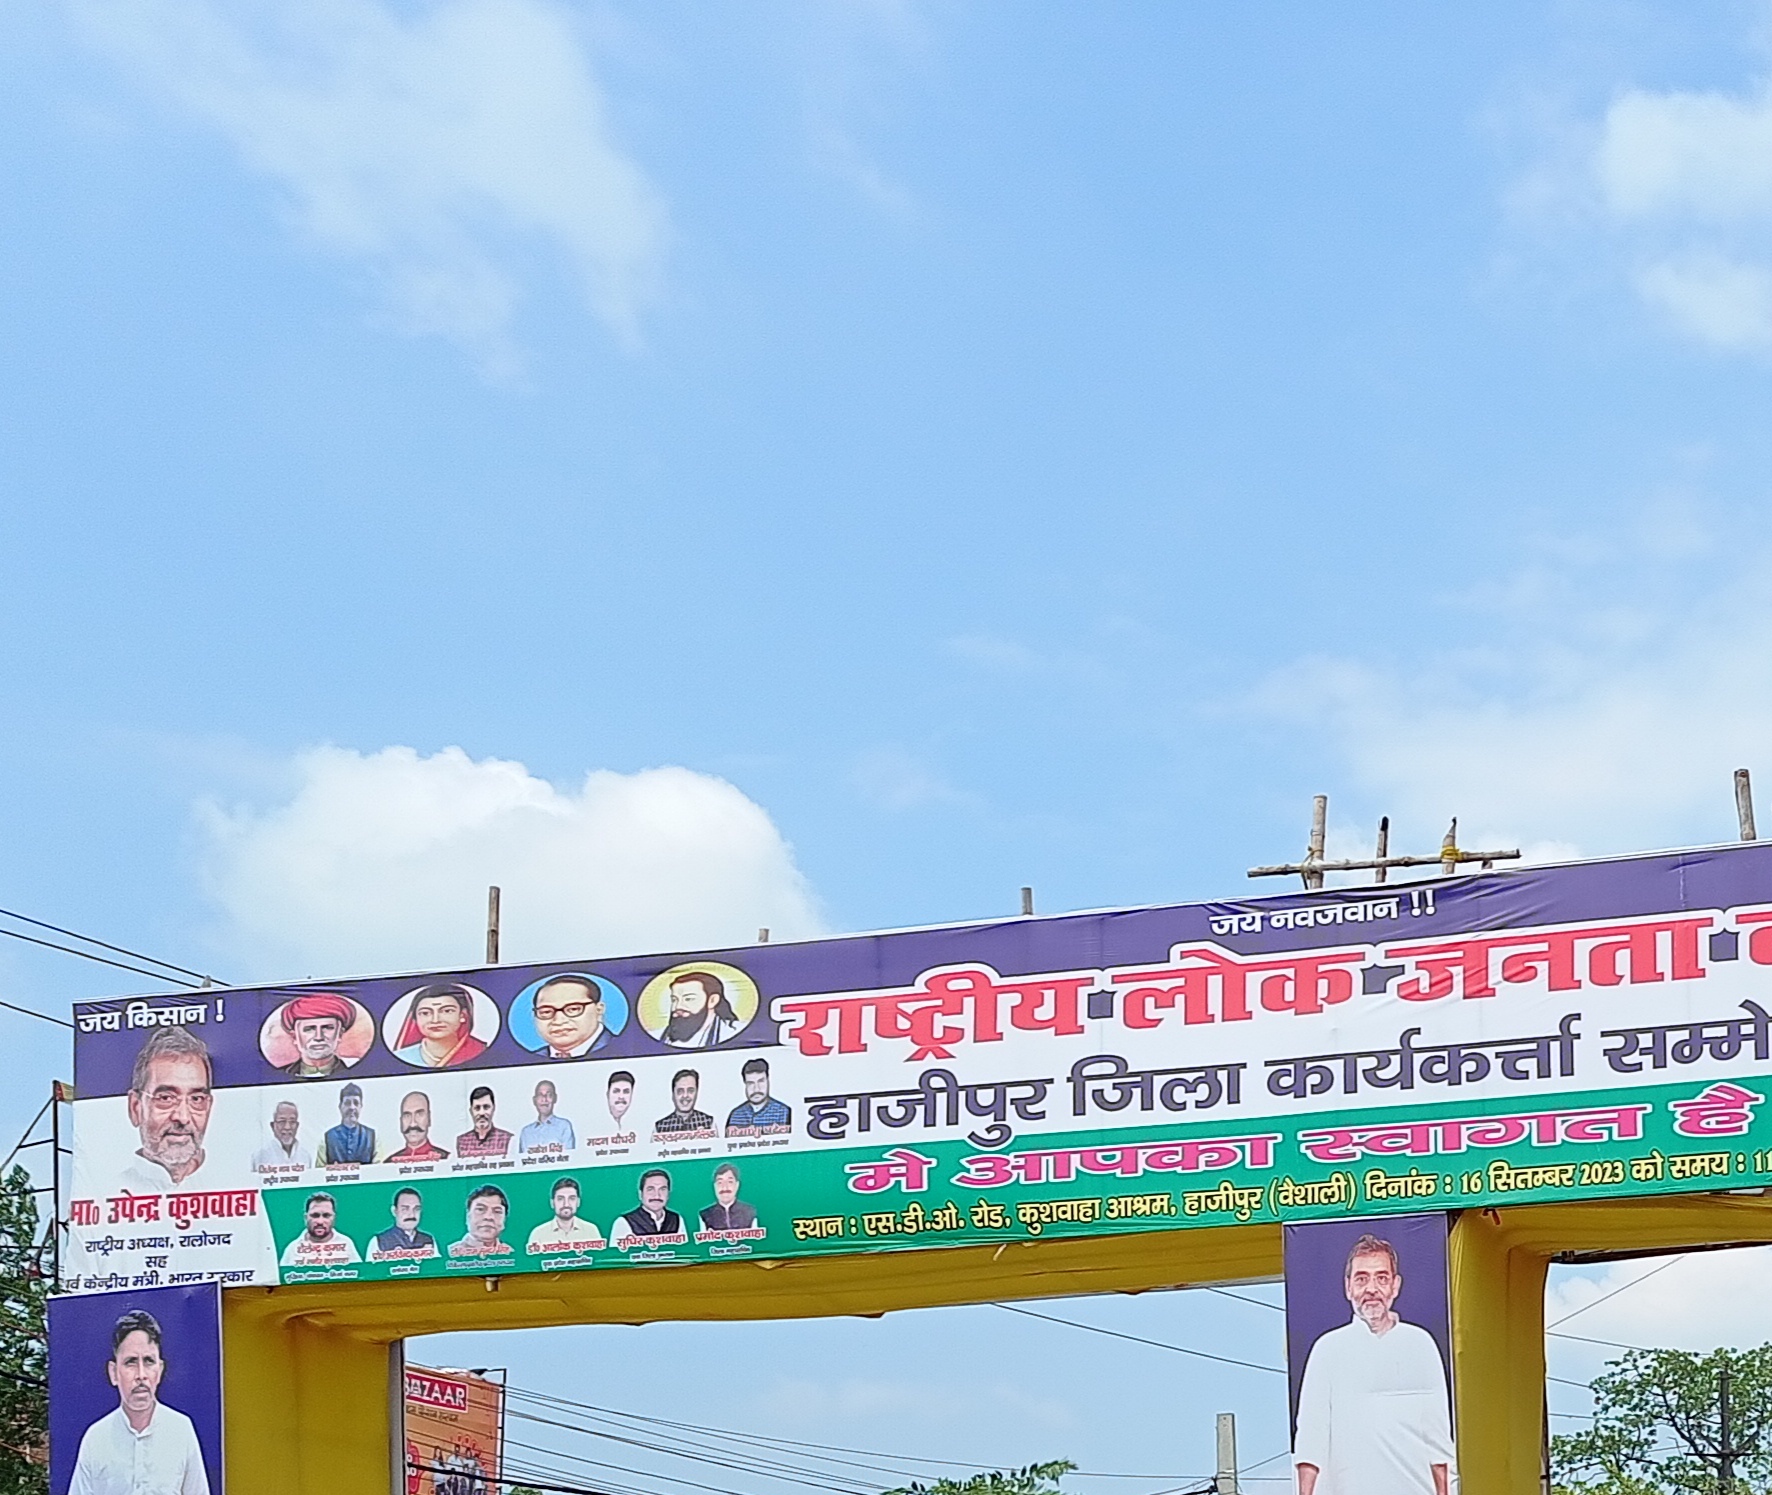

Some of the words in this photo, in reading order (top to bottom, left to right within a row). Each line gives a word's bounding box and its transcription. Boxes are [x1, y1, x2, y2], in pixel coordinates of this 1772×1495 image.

[1209, 911, 1264, 936] जय
[1270, 898, 1399, 930] नवजवान
[1410, 889, 1437, 917] !!
[780, 967, 1095, 1063] राष्ट्रीय
[1113, 949, 1364, 1029] लोक
[1387, 917, 1713, 1001] जनता
[77, 1011, 122, 1032] जय
[126, 1001, 207, 1028] किसान
[215, 998, 225, 1021] !
[805, 1067, 1057, 1147] हाजीपुर
[1068, 1055, 1248, 1116] जिला
[1265, 1014, 1581, 1097] कार्यकर्त्ता
[587, 1137, 609, 1147] मदन
[611, 1132, 637, 1145] चौधरी
[847, 1151, 934, 1192] मे
[954, 1134, 1279, 1189] आपका
[1306, 1105, 1648, 1163] स्वागत
[1676, 1085, 1762, 1136] है
[106, 1189, 162, 1225] उपेन्द्र
[166, 1189, 259, 1230] कुशवाहा
[794, 1215, 846, 1241] स्थान
[862, 1200, 966, 1236] एस.डी.ओ.
[970, 1195, 1012, 1233] रोड,
[1017, 1195, 1101, 1235] कुशवाहा
[1105, 1190, 1178, 1220] आश्रम,
[1182, 1185, 1266, 1222] हाजीपुर
[1270, 1170, 1357, 1210] (वैशाली)
[1363, 1169, 1437, 1200] दिनांक
[1460, 1169, 1483, 1193] 16
[1487, 1162, 1576, 1191] सितम्बर
[1581, 1160, 1625, 1184] 2023
[1631, 1154, 1664, 1181] को
[1668, 1151, 1729, 1178] समय
[85, 1235, 125, 1256] राष्ट्रीय
[127, 1236, 174, 1250] अध्यक्ष,
[179, 1230, 232, 1248] रालोजद
[542, 1240, 571, 1251] आलोक
[573, 1240, 606, 1254] कुशवाहा
[646, 1234, 686, 1248] कुशवाहा
[695, 1230, 722, 1242] प्रमोद
[725, 1229, 765, 1243] कुशवाहा
[145, 1255, 169, 1268] सह
[84, 1272, 129, 1293] केन्द्रीय
